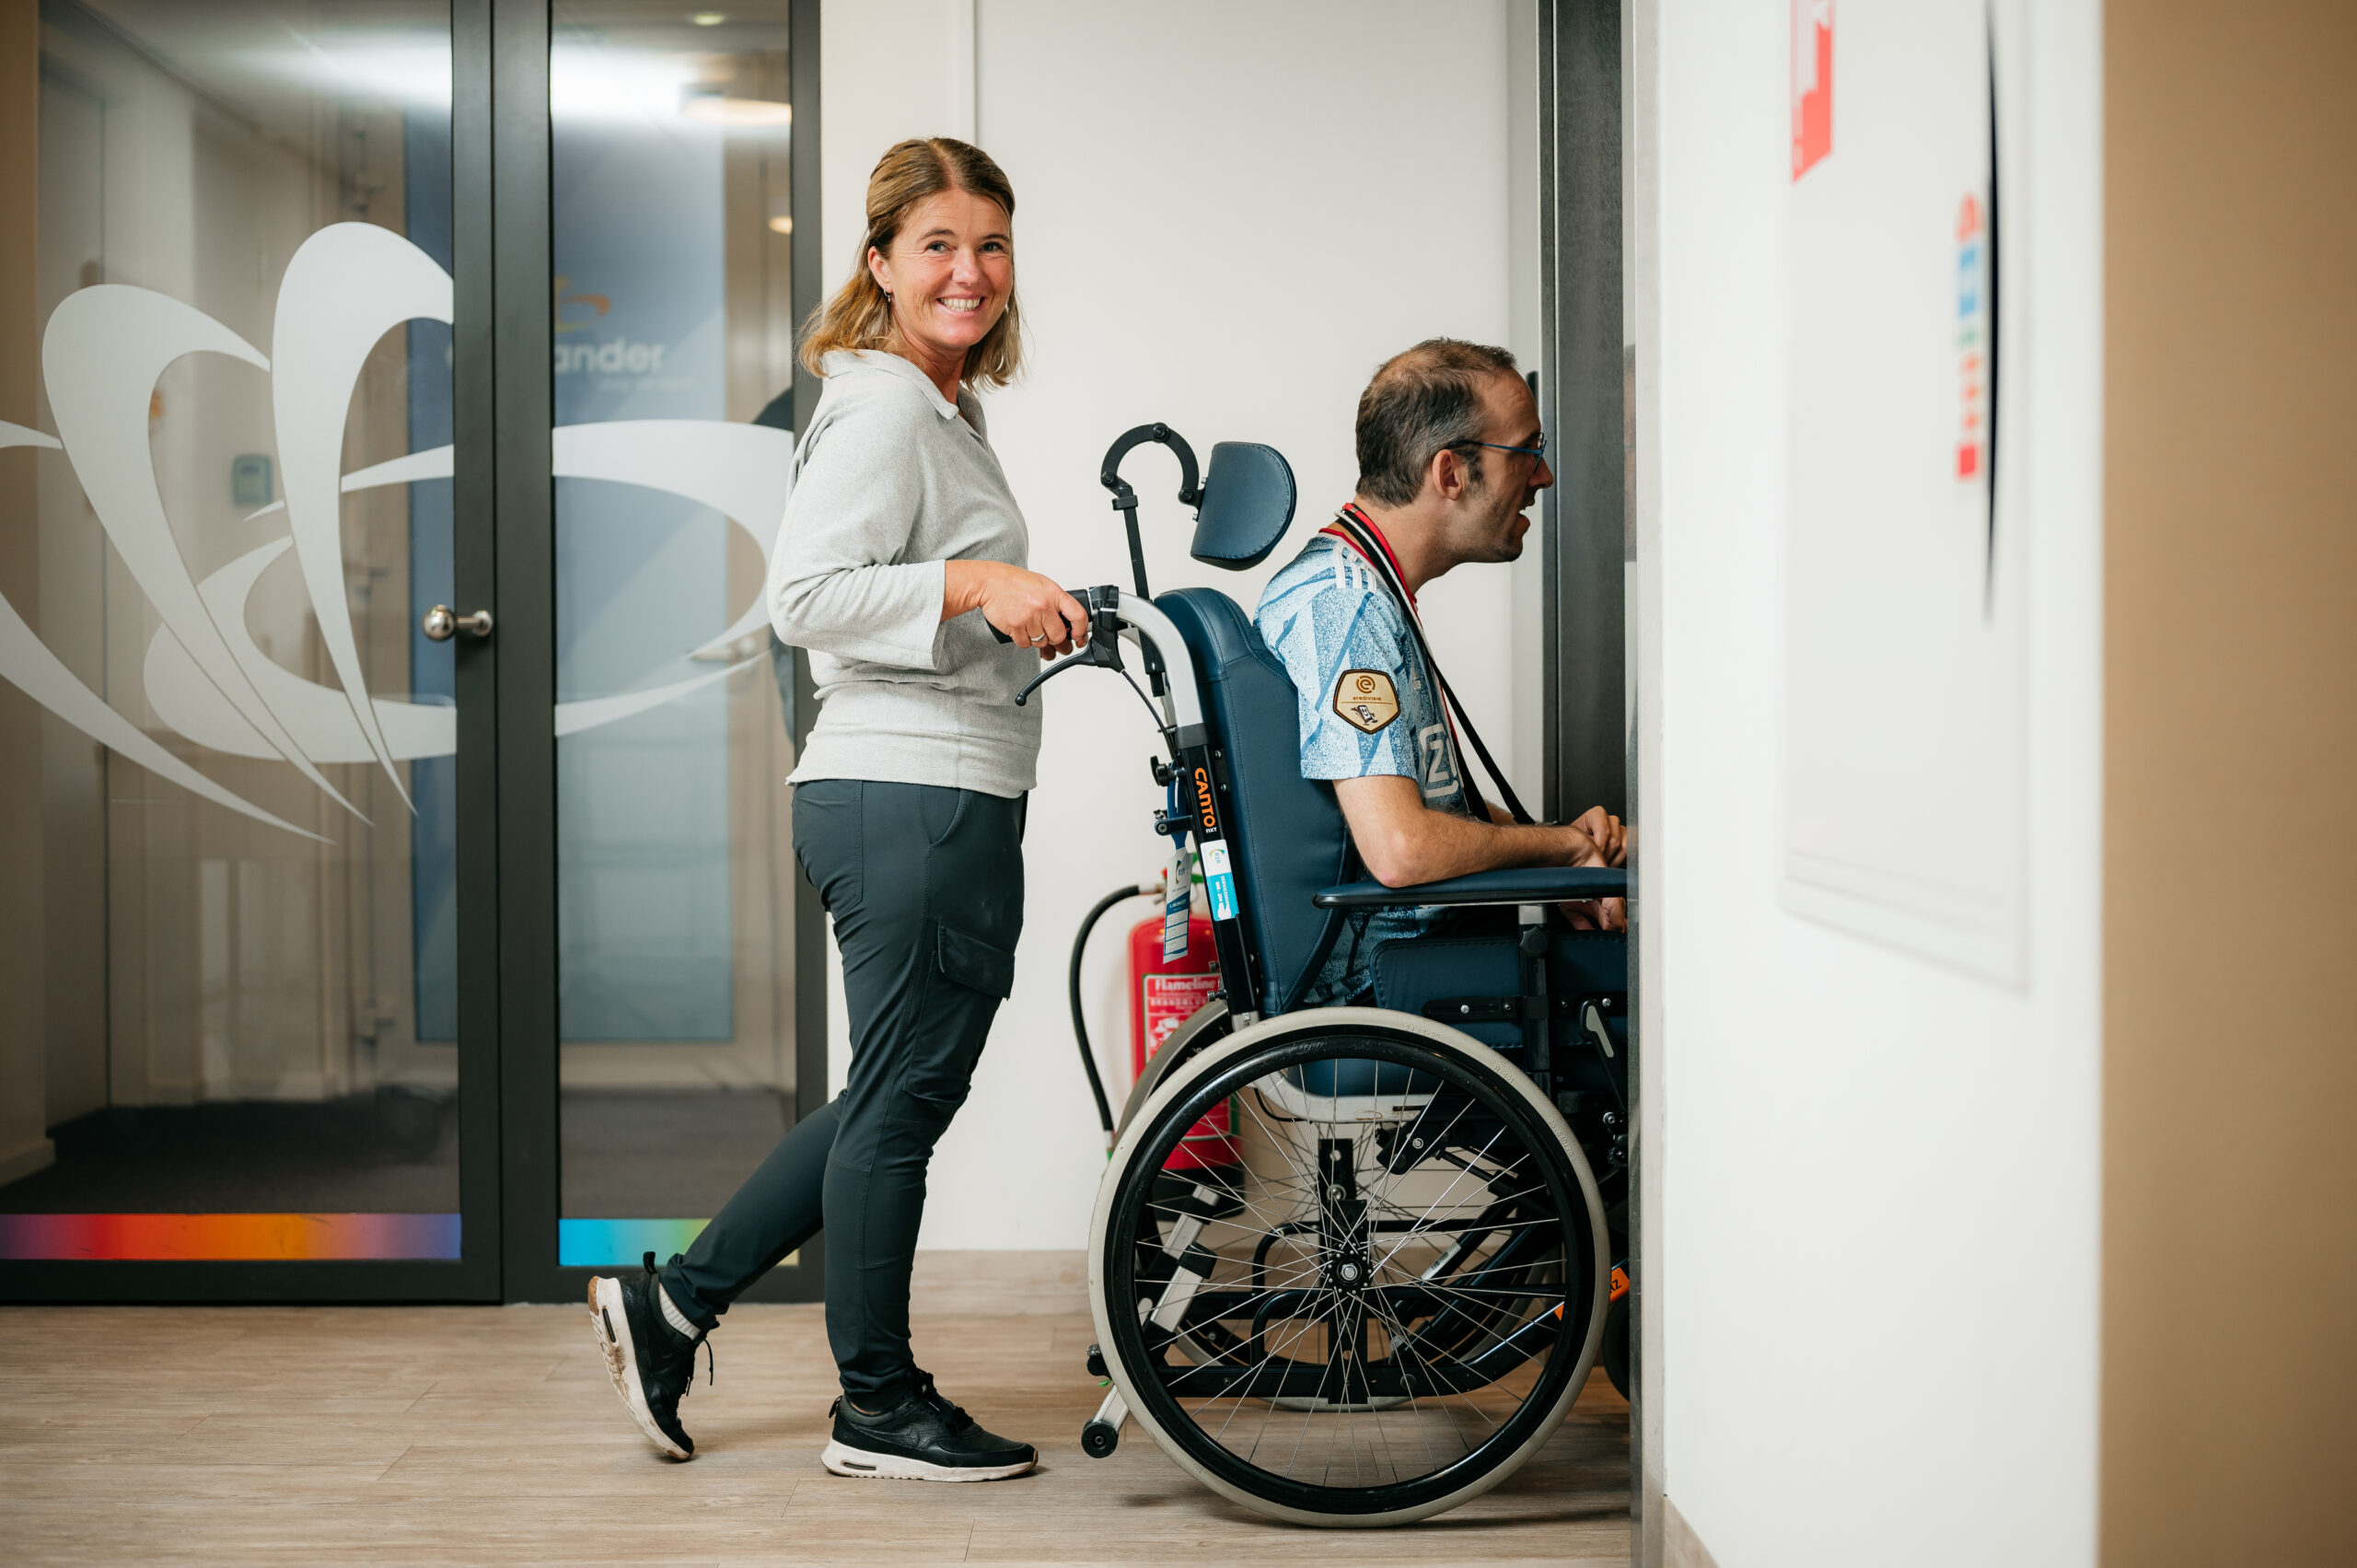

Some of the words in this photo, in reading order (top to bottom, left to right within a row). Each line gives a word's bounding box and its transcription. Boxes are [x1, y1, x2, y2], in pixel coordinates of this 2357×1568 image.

[554, 337, 664, 372] ander
[1194, 767, 1216, 828] CANTO
[1155, 978, 1215, 991] Flameline
